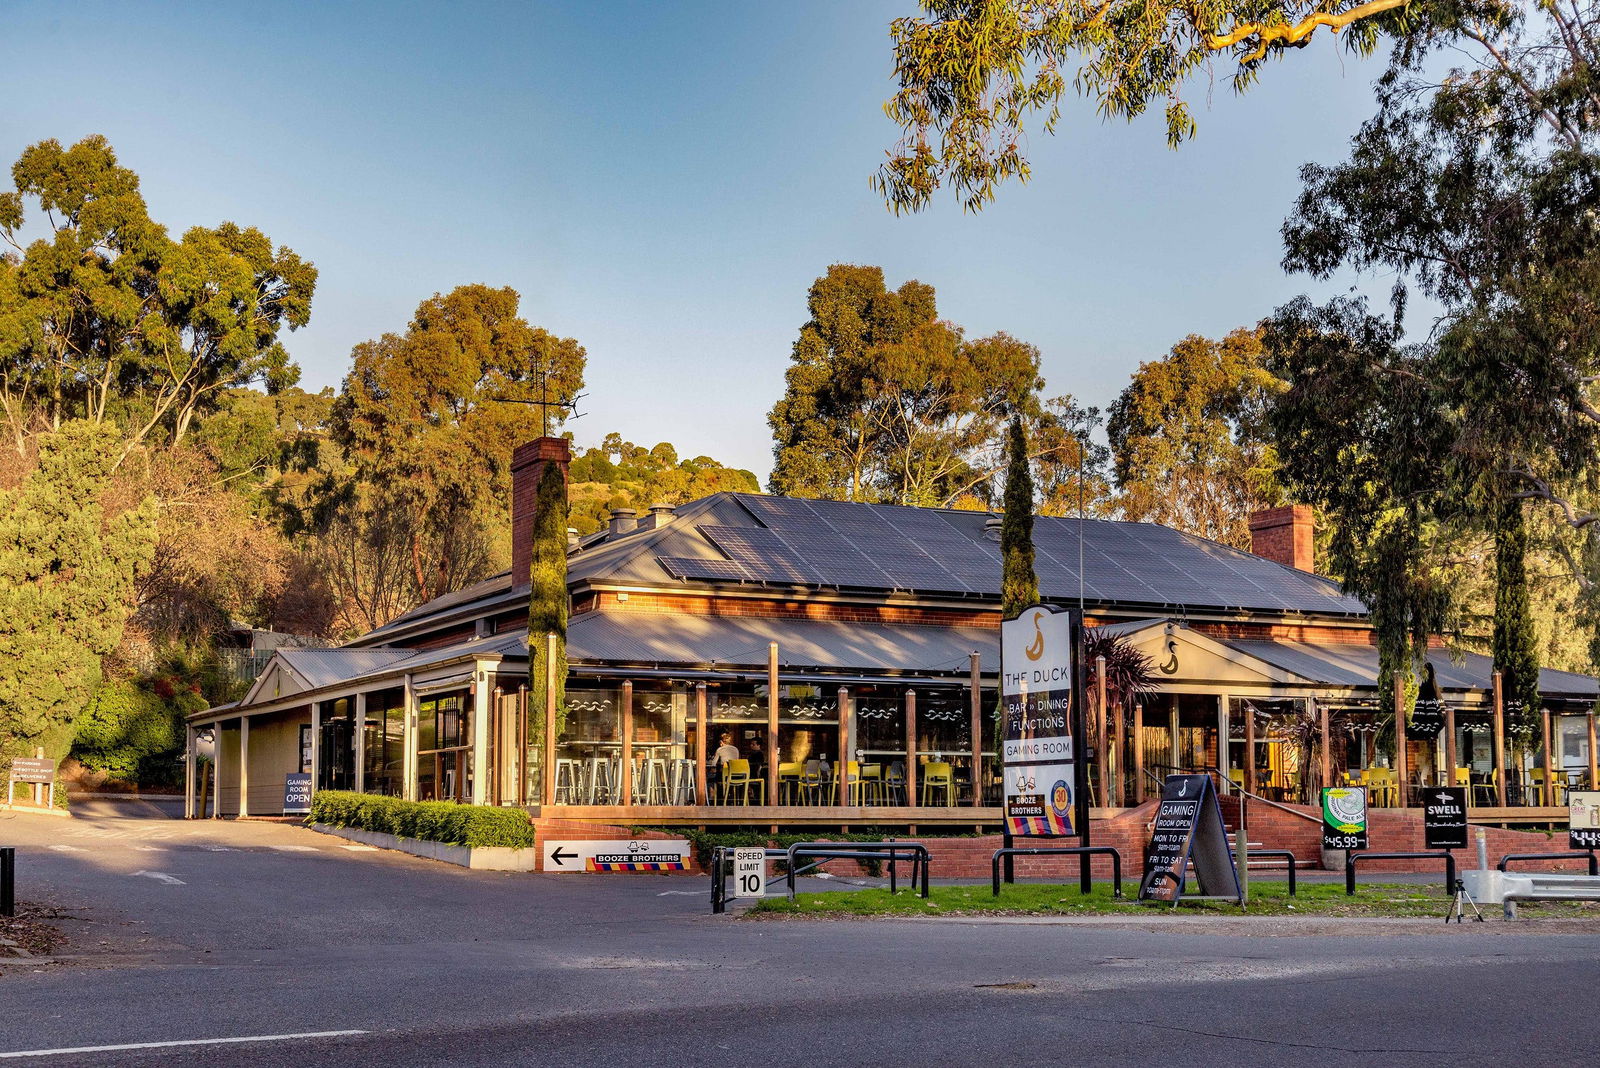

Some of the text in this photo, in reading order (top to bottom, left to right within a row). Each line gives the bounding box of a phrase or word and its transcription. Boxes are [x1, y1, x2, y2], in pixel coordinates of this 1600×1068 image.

[1005, 667, 1069, 686] THE DUCK
[1009, 698, 1068, 714] BAR DINING
[1012, 716, 1065, 731] FUNCTIONS
[1006, 742, 1070, 756] GAMING ROOM
[286, 794, 311, 803] OPEN
[1016, 796, 1037, 805] BOOZE
[1056, 789, 1066, 803] 30
[1011, 806, 1042, 815] BROTHERS
[1161, 805, 1194, 816] GAMING
[1428, 805, 1462, 815] SWELL
[1158, 819, 1191, 827] ROOM OPEN
[1153, 834, 1189, 842] MON TO FRI
[1324, 835, 1358, 848] $45.99
[632, 854, 679, 862] BROTHERS
[737, 852, 763, 860] SPEED
[1149, 856, 1183, 864] FRI TO SAT
[739, 863, 760, 871] LIMIT
[739, 874, 760, 893] 10
[1154, 877, 1168, 886] SUN
